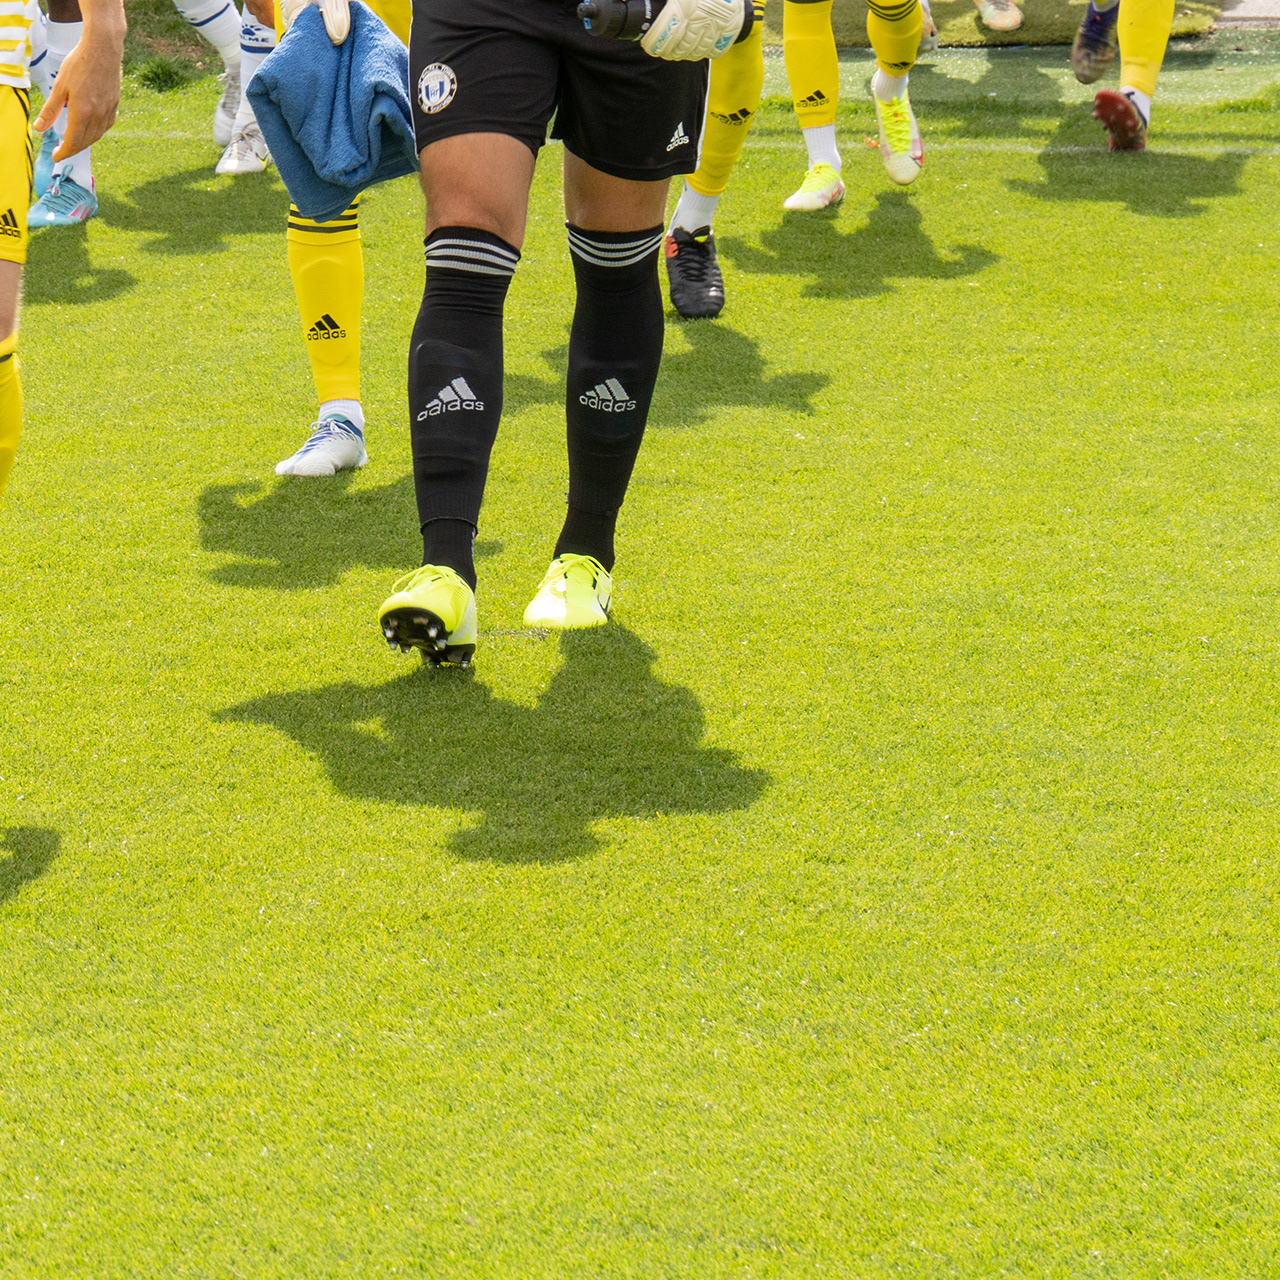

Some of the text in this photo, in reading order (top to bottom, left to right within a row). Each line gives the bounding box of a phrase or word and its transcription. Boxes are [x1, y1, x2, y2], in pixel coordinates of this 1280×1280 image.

[306, 327, 347, 341] adidas
[416, 398, 485, 422] adidas
[578, 393, 637, 413] adidas
